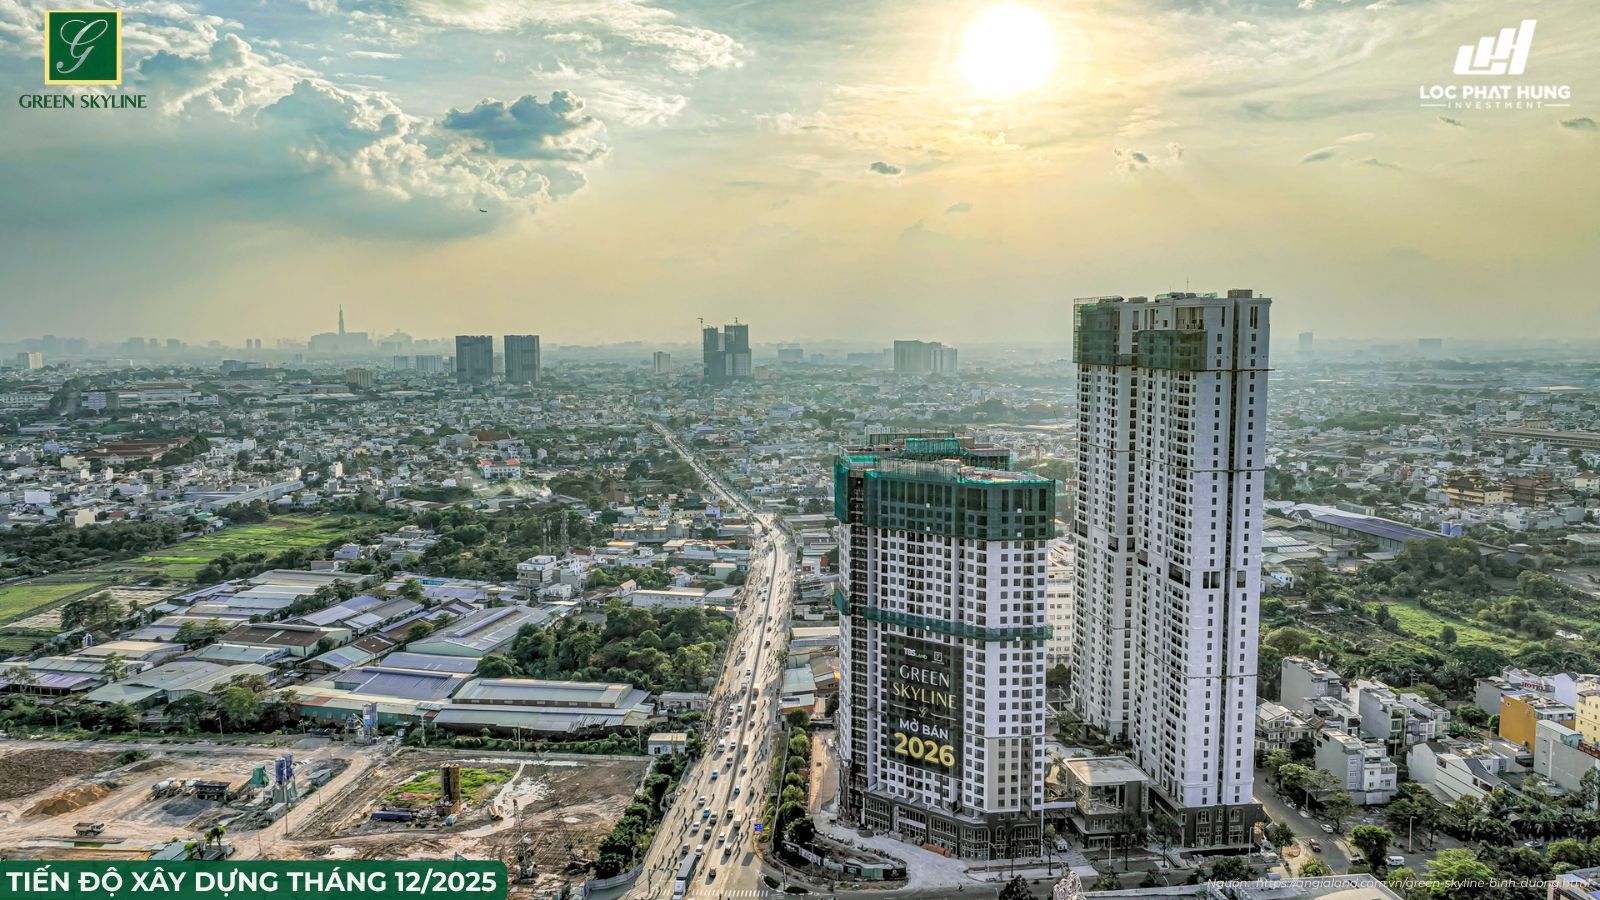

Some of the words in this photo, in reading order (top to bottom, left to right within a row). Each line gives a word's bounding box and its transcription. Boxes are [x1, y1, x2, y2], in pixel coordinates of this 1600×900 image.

[899, 664, 950, 688] GREEN
[892, 681, 957, 710] SKYLINE
[899, 717, 919, 732] MỞ
[922, 724, 949, 740] BÁN
[894, 732, 956, 767] 2026
